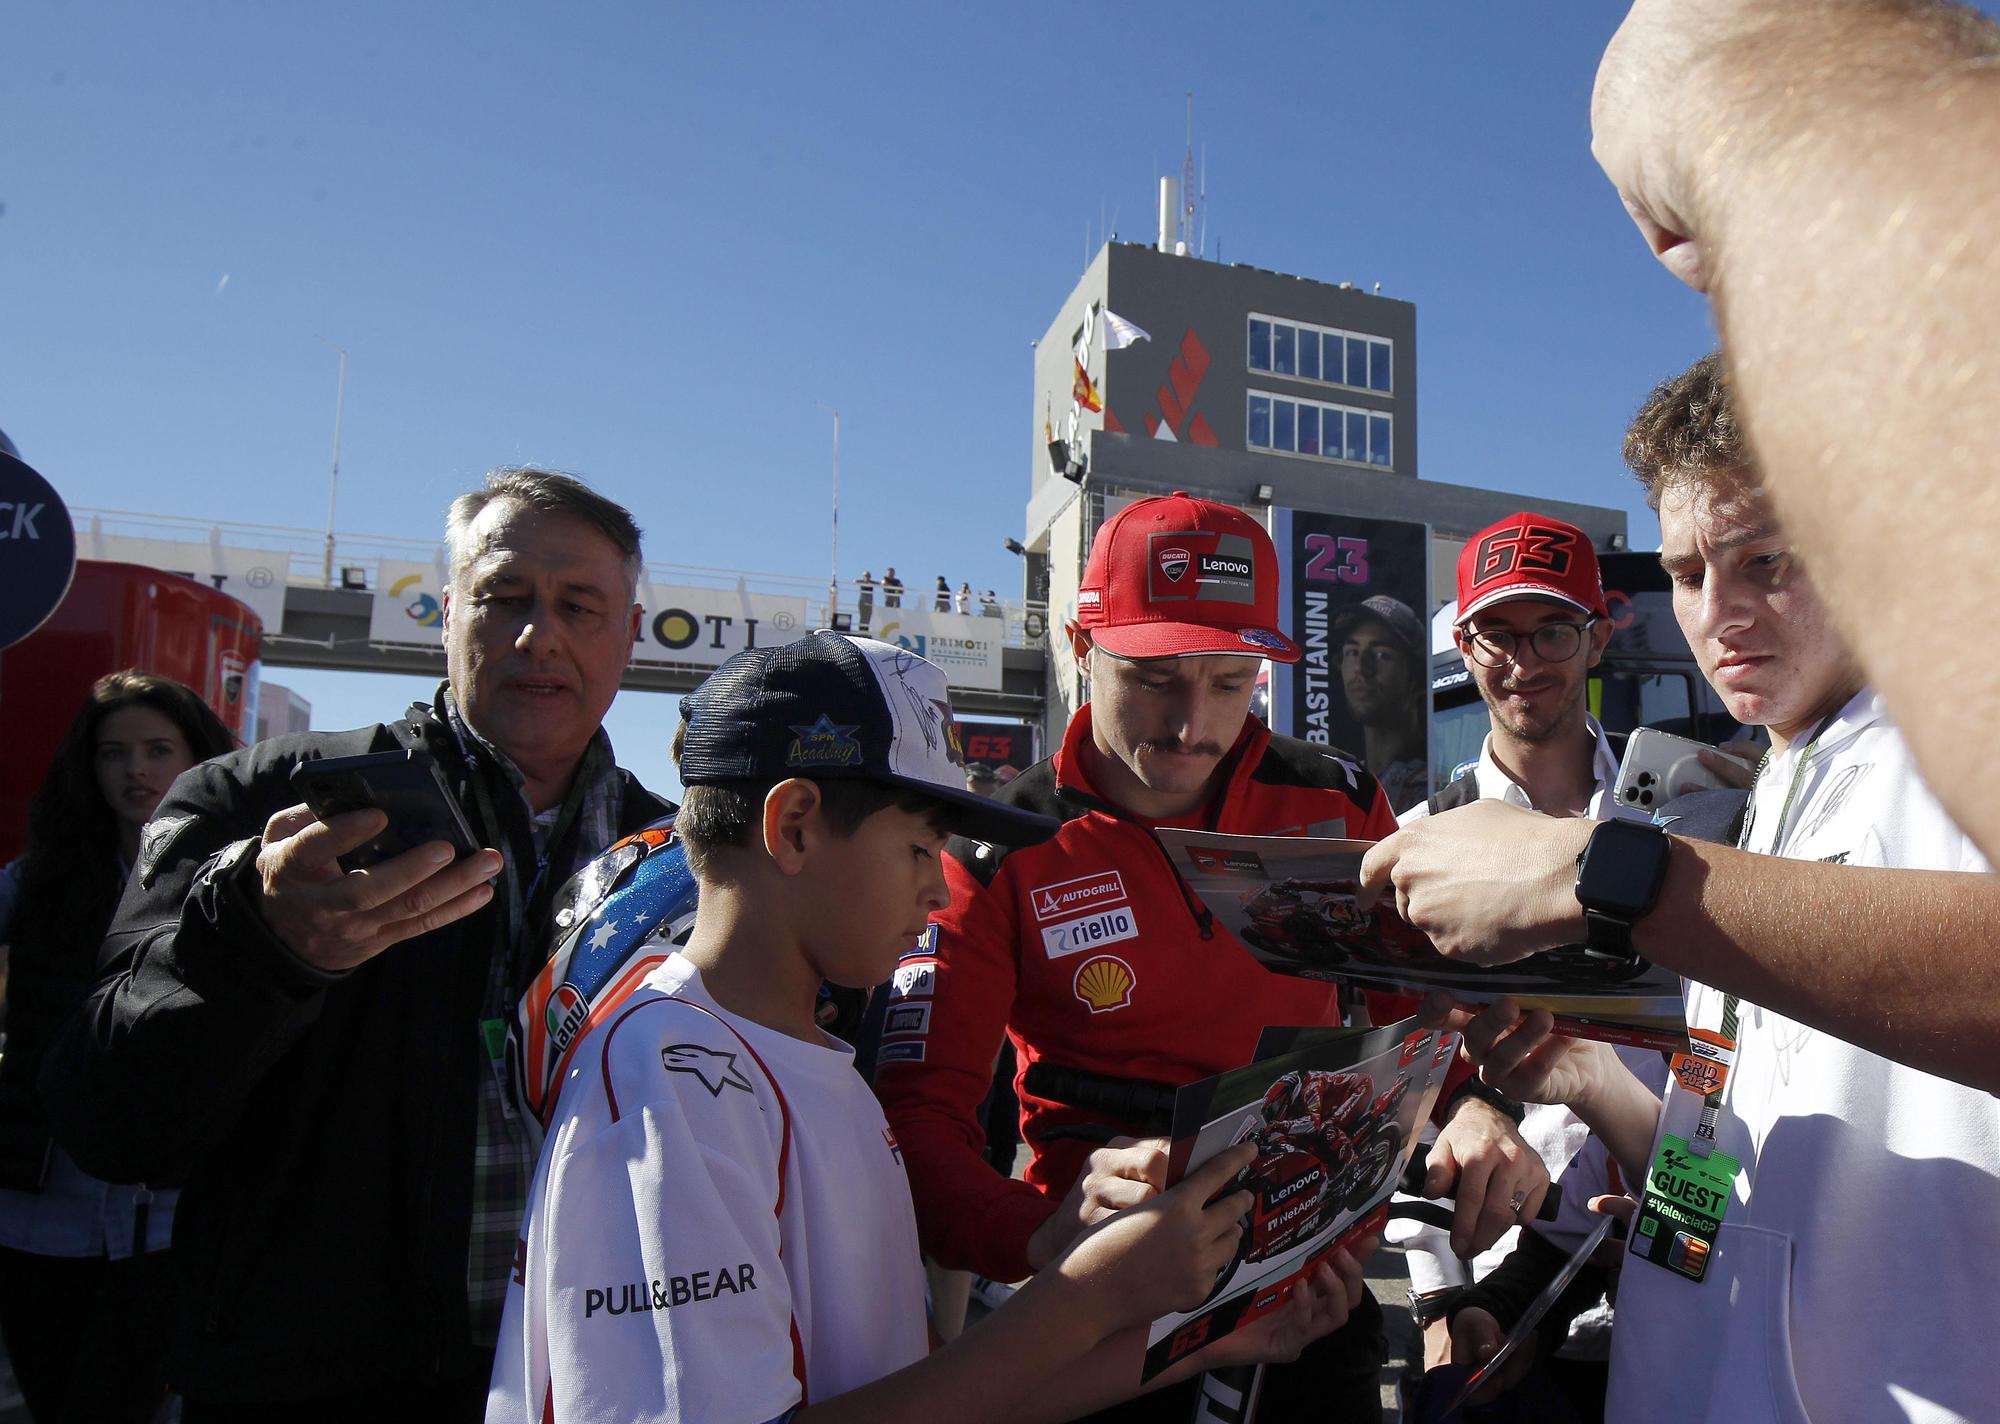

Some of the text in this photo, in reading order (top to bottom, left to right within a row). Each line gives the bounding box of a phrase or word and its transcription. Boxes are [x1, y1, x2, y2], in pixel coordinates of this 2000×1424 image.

[1202, 558, 1249, 574] Lenovo
[1305, 533, 1369, 584] 23
[1472, 525, 1577, 589] 63
[636, 607, 759, 652] OTI
[930, 636, 988, 650] PRIMOTI
[1305, 591, 1330, 746] BASTIANINI
[791, 739, 857, 766] Academy
[811, 734, 836, 742] SPN
[966, 735, 1012, 759] 63
[1062, 882, 1120, 904] AUTOGRILL
[1072, 915, 1129, 945] riello
[1681, 1070, 1714, 1092] 2022
[1682, 1058, 1719, 1081] GRID
[1270, 1168, 1320, 1204] Lenovo
[1654, 1171, 1725, 1213] GUEST
[1279, 1194, 1320, 1225] NetApp
[1647, 1197, 1717, 1234] #ValenciaGP
[585, 1263, 757, 1318] PULL&BEAR
[1257, 1294, 1276, 1308] Lenovo
